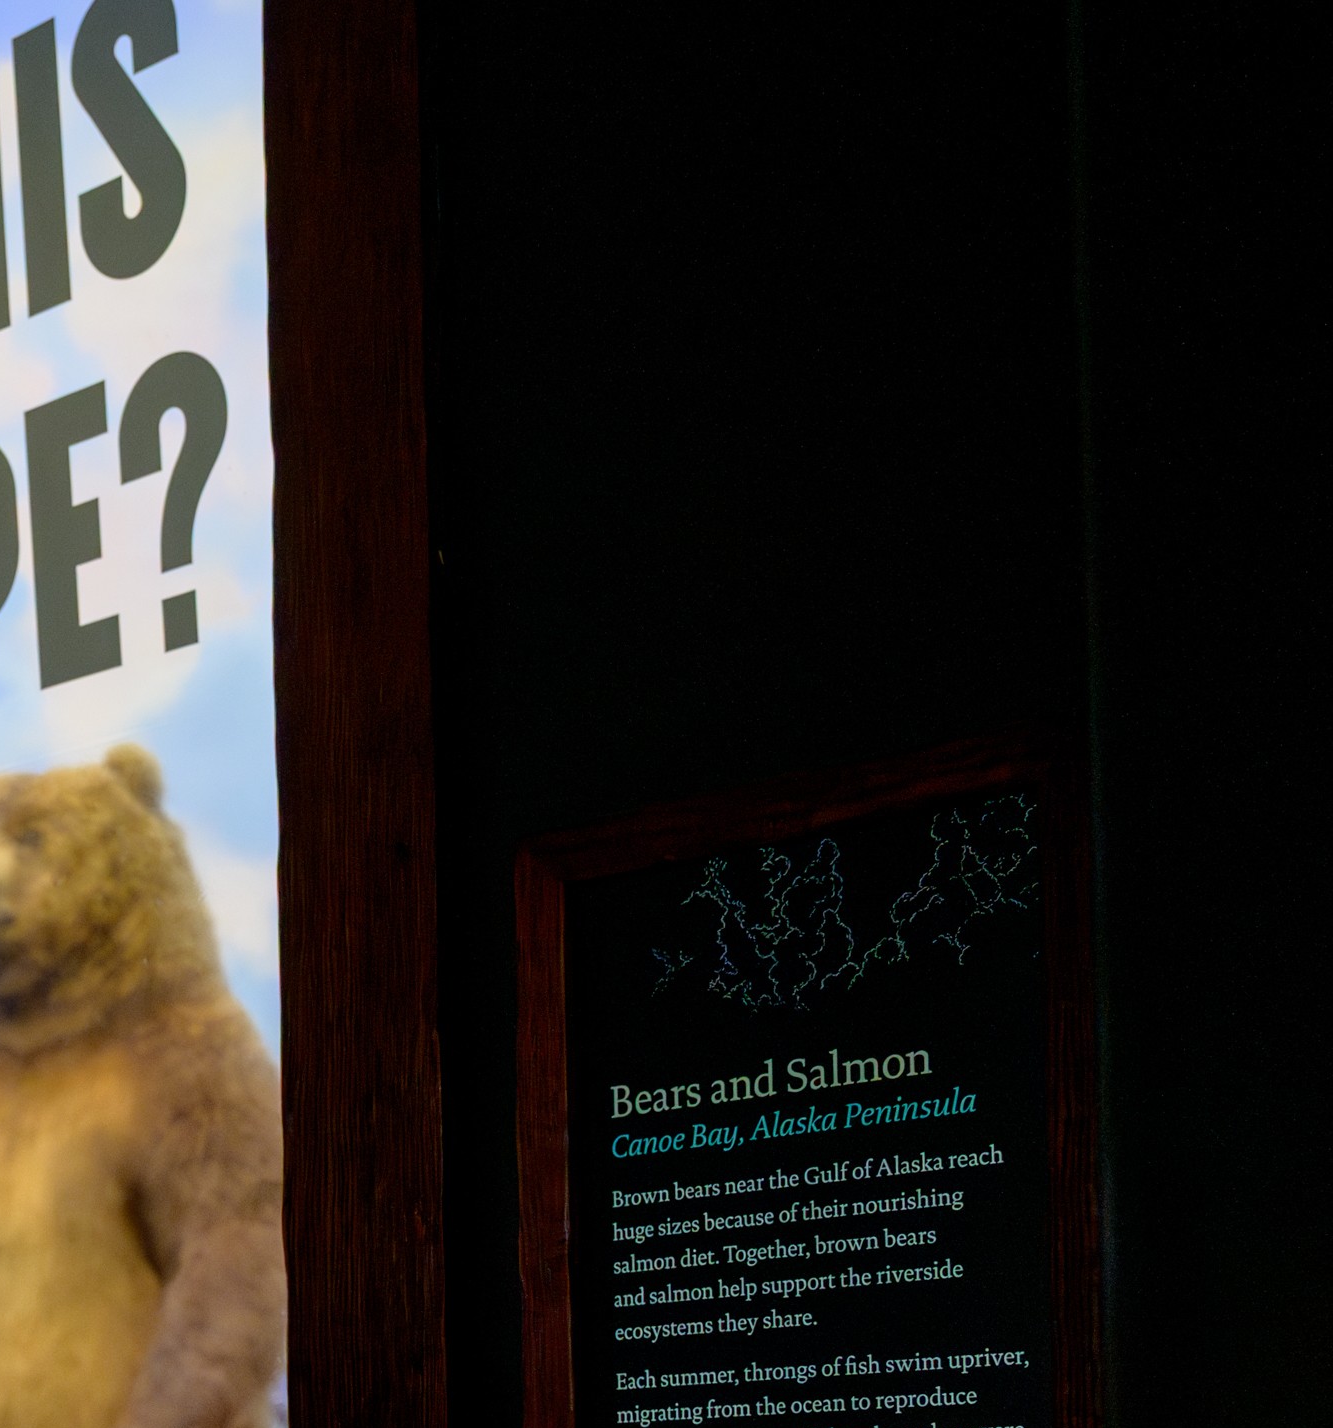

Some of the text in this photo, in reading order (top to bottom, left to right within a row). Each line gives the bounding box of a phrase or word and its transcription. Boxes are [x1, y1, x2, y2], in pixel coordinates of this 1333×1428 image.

[609, 1048, 933, 1119] Bears and Salmon
[611, 1085, 977, 1159] Canoe Bay, Alaska Peninsula
[611, 1143, 1005, 1208] Brown bears near the Gulf of Alaska reach
[612, 1188, 964, 1244] huge sizes because of their nourishing
[613, 1227, 937, 1275] salmon diet. Together, brown bears
[613, 1257, 964, 1308] and salmon help support the riverside
[614, 1308, 818, 1344] ecosystems they share.
[615, 1347, 1030, 1391] Each summer, throngs of fish swim upriver,
[616, 1385, 978, 1428] migrating from the ocean to reproduce
